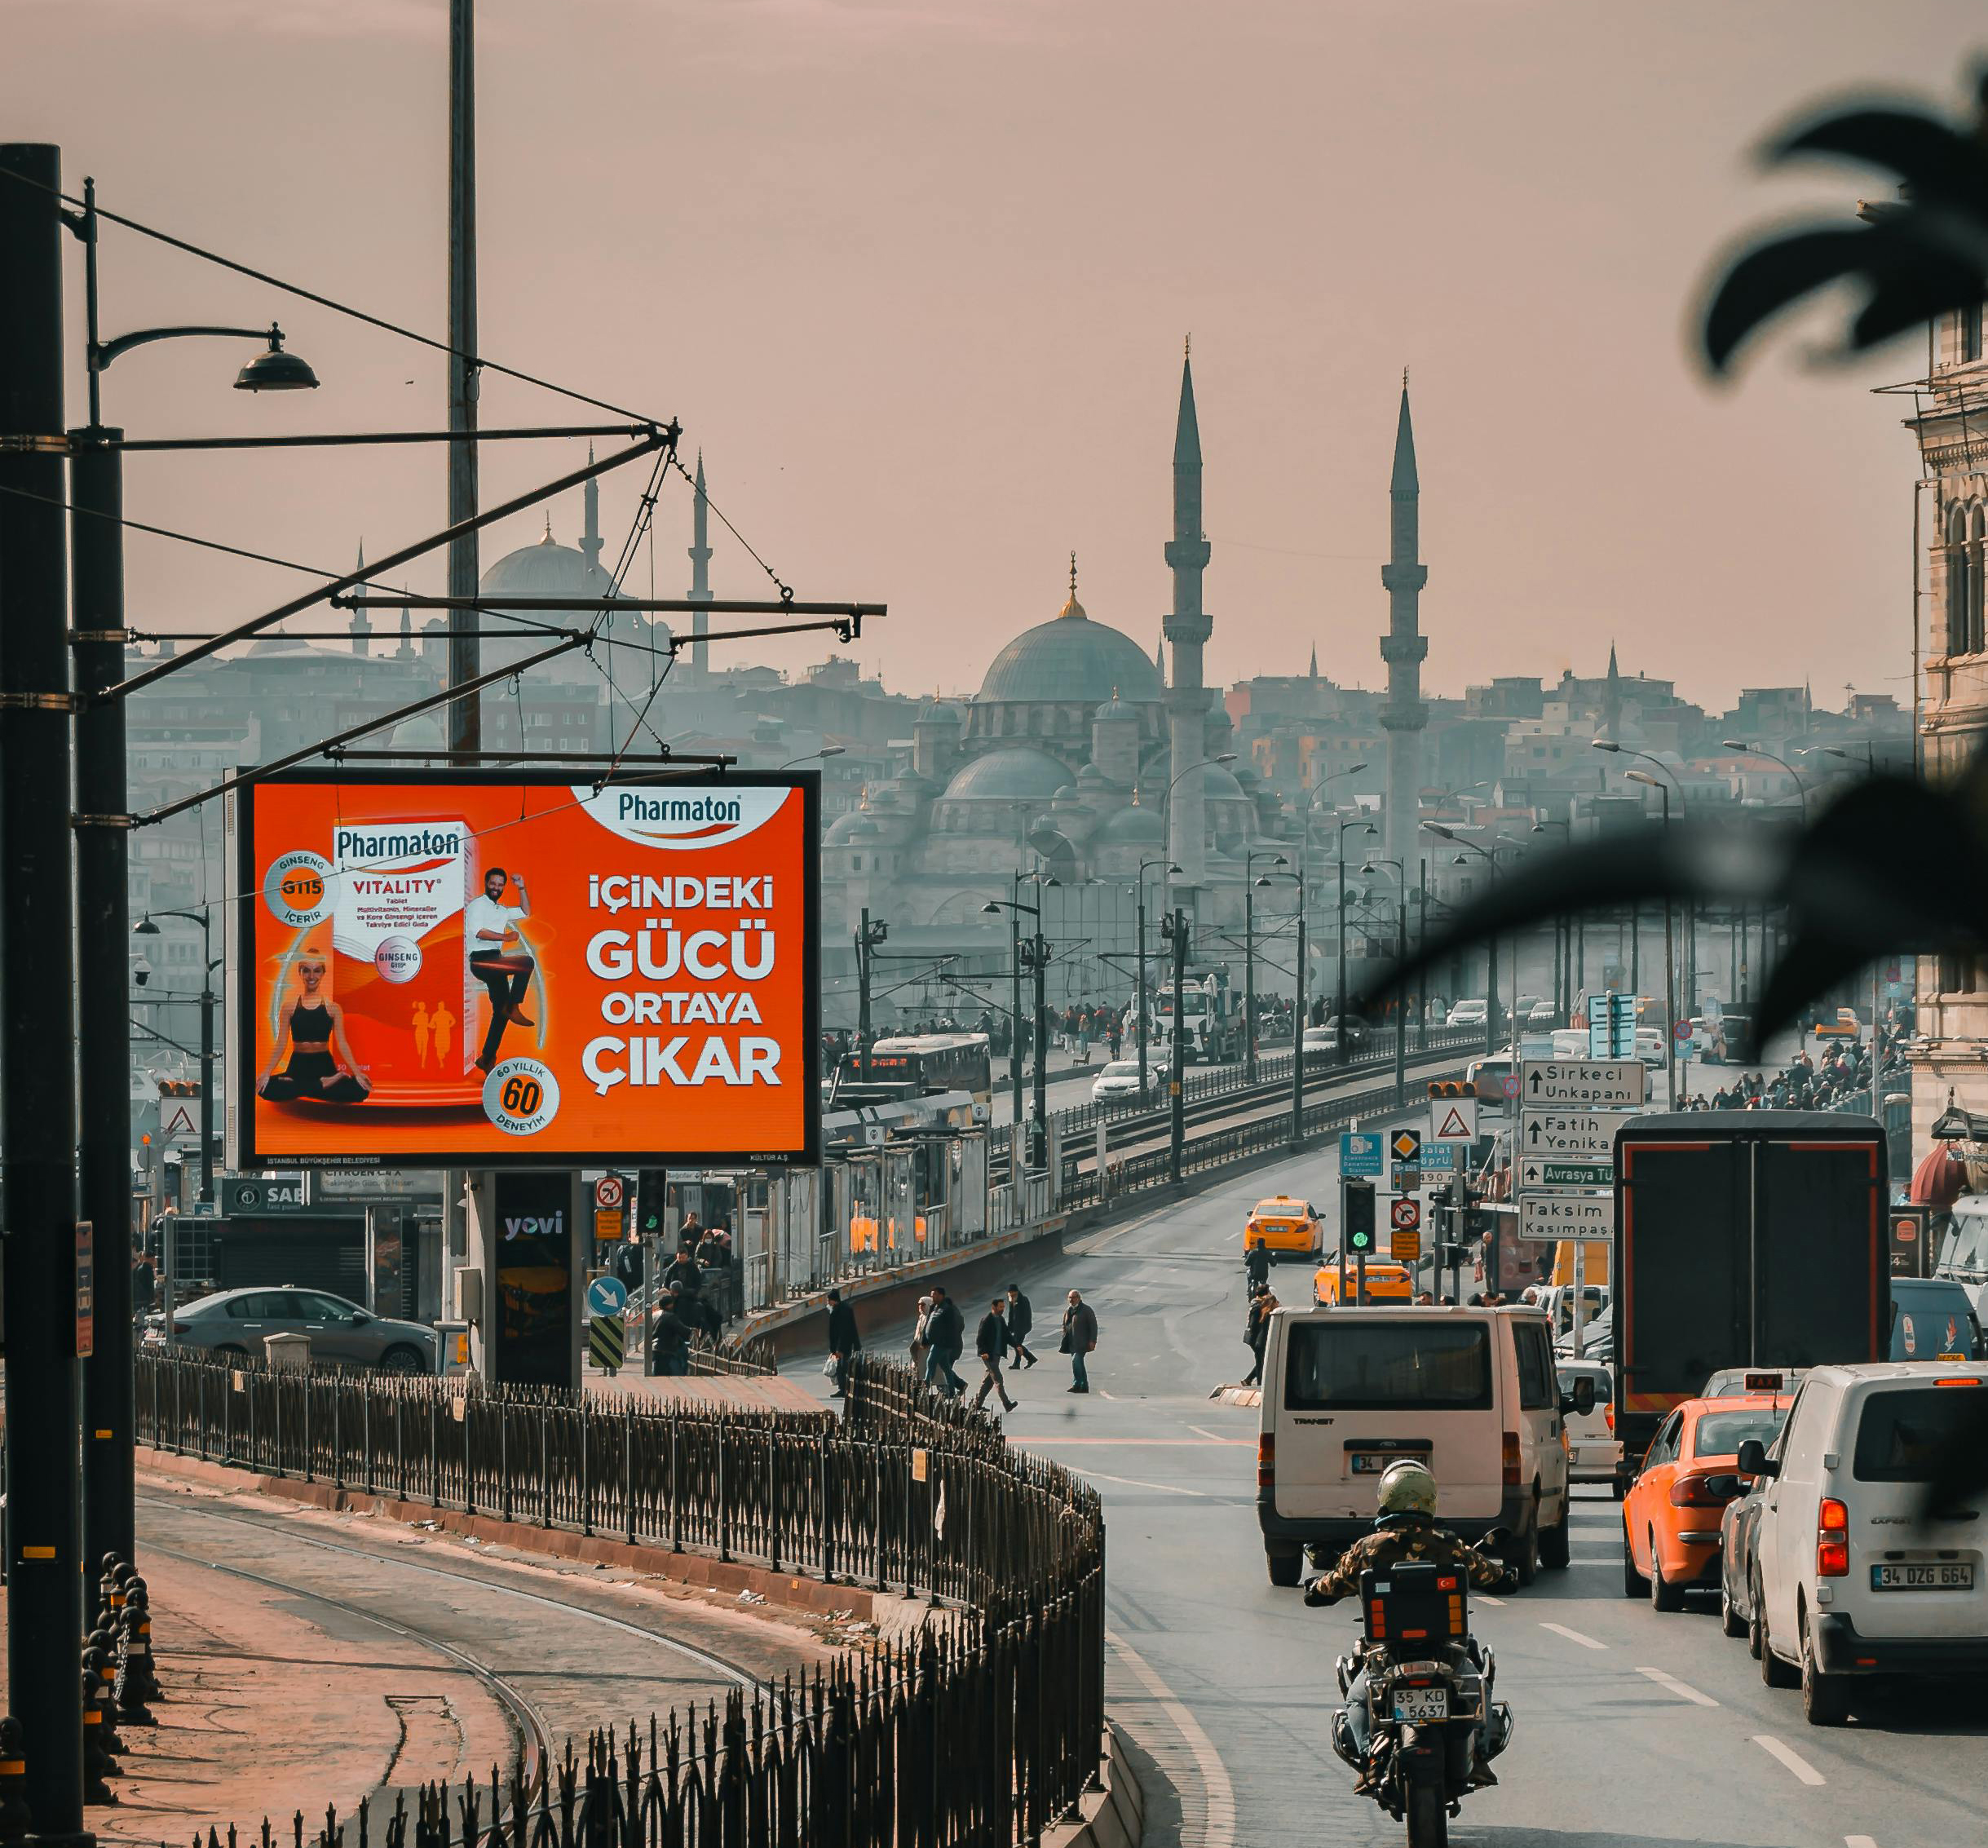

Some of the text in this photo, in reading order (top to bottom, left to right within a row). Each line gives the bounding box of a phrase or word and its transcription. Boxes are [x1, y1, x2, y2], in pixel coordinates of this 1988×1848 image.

[619, 793, 740, 821] Pharmaton
[338, 829, 459, 858] Pharmaton
[281, 880, 323, 895] G115
[589, 874, 774, 914] İÇİNDEKİ
[585, 918, 775, 980] GÜCÜ
[378, 953, 418, 962] GINSENG
[600, 992, 763, 1024] ORTAYA
[497, 1066, 510, 1078] 60
[581, 1036, 783, 1096] ÇIKAR
[1546, 1065, 1623, 1081] Sirkeci
[503, 1077, 540, 1115] 60
[1545, 1085, 1631, 1102] Unkapanı
[495, 1113, 546, 1131] DENEYİM
[1545, 1116, 1599, 1131] Fatih
[1545, 1134, 1610, 1150] Yenika
[267, 1156, 298, 1165] İSTANBUL
[749, 1153, 775, 1161] KÜLTÜR
[1545, 1166, 1594, 1183] Avrasya
[1526, 1201, 1602, 1217] Taksim
[505, 1210, 563, 1241] yovi
[1526, 1222, 1614, 1236] Kasımpaş
[1292, 1417, 1335, 1426] TRANSIT
[1360, 1456, 1373, 1469] 34
[1882, 1567, 1968, 1584] 34 DZG 664
[1395, 1690, 1445, 1704] 35 KD
[1408, 1704, 1445, 1718] 5637
